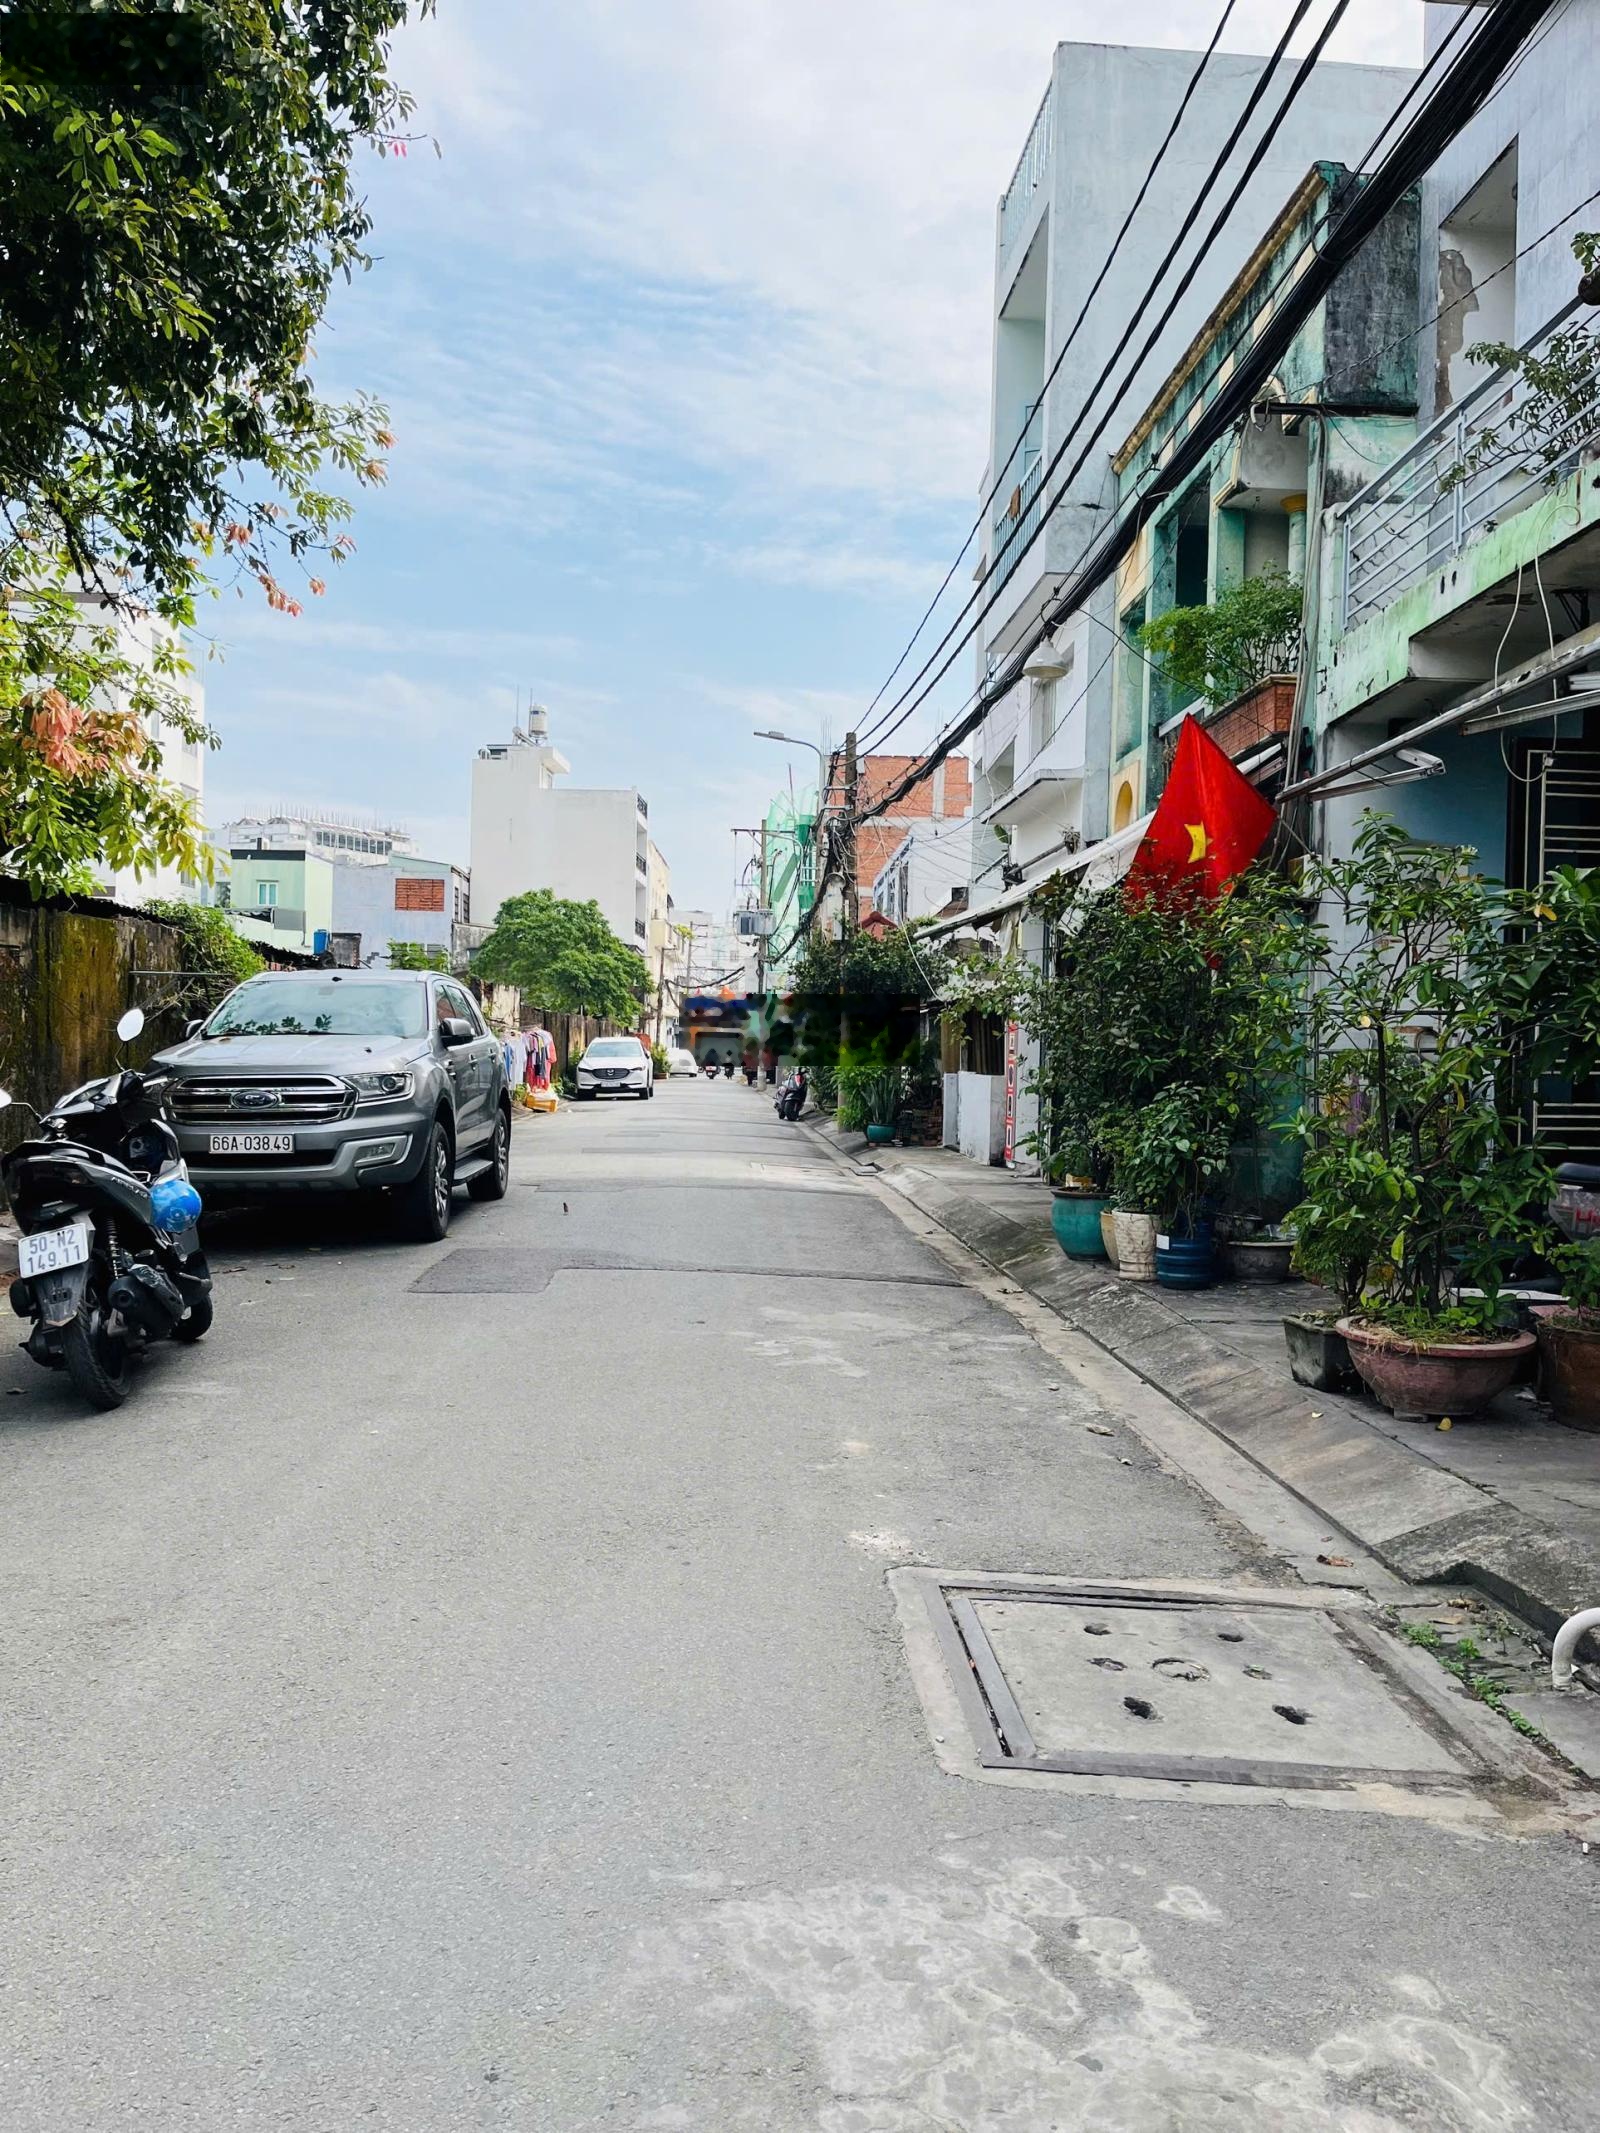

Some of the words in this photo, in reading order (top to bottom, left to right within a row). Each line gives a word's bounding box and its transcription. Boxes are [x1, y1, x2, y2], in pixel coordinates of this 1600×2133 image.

[212, 1136, 291, 1151] 66A-038.49
[29, 1229, 75, 1254] 50-N2
[27, 1245, 80, 1273] 149.11
